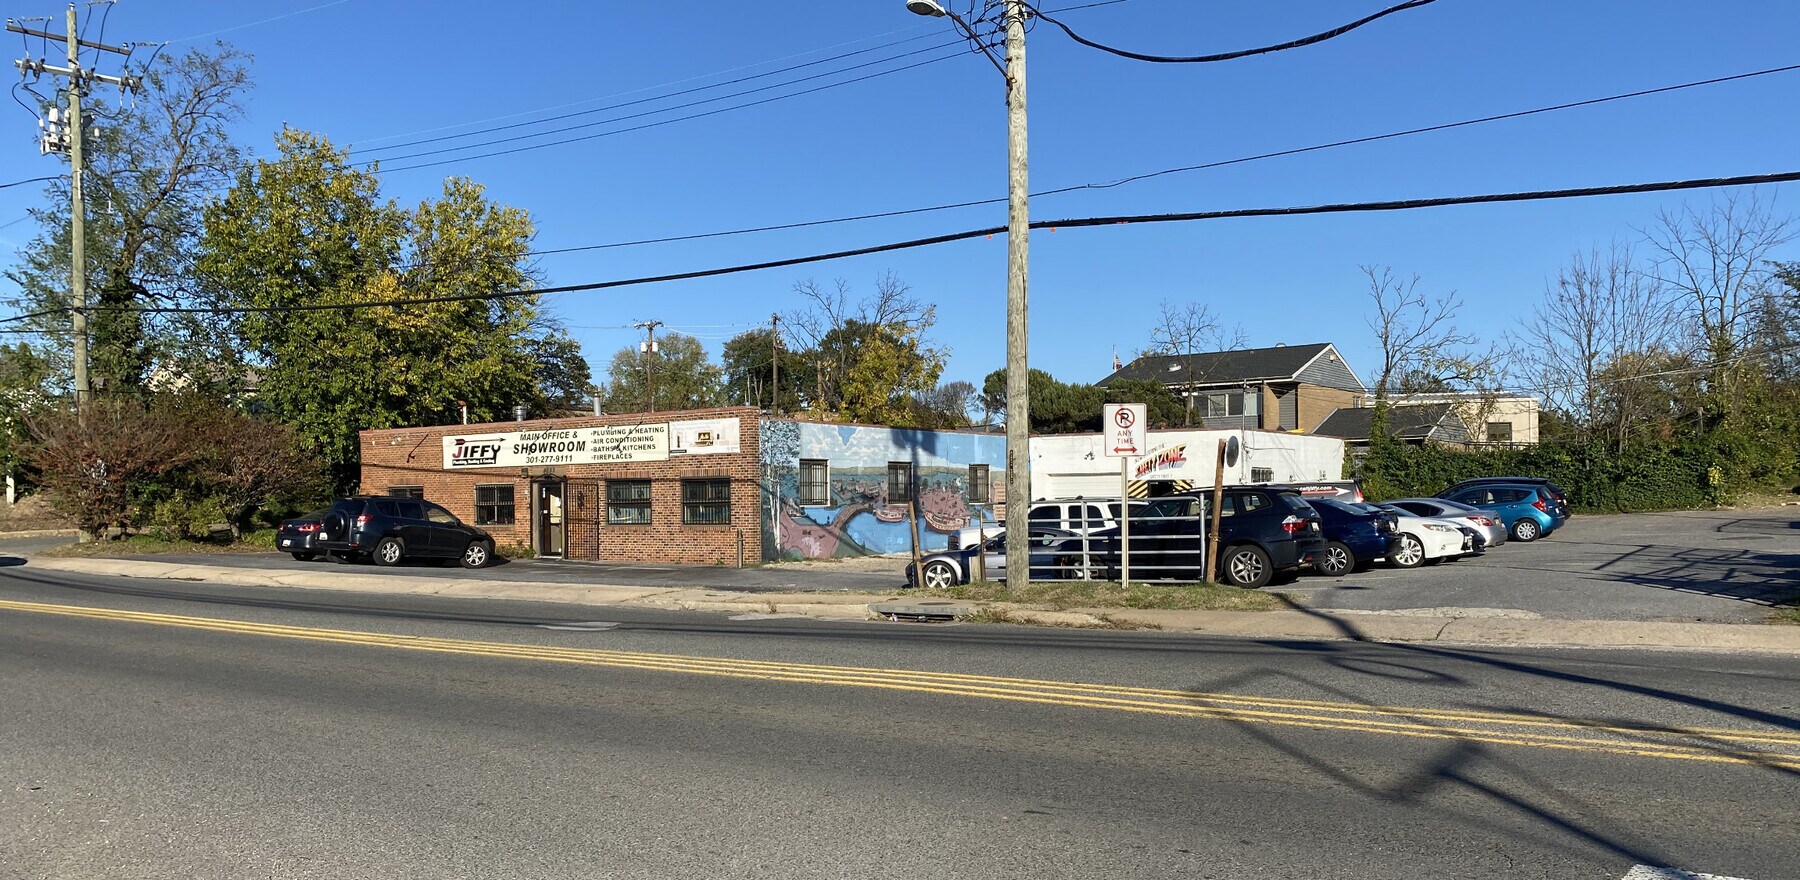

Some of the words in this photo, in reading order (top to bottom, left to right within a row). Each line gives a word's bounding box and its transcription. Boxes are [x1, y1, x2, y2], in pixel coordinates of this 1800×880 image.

[519, 432, 541, 441] MAIN
[541, 431, 570, 440] OFFICE
[572, 430, 578, 439] &
[605, 436, 654, 444] CONDITIONING
[452, 444, 501, 461] JIFFY
[513, 440, 586, 455] SHOWROOM
[526, 455, 573, 464] 301-277-9111
[1158, 443, 1187, 467] ZONE
